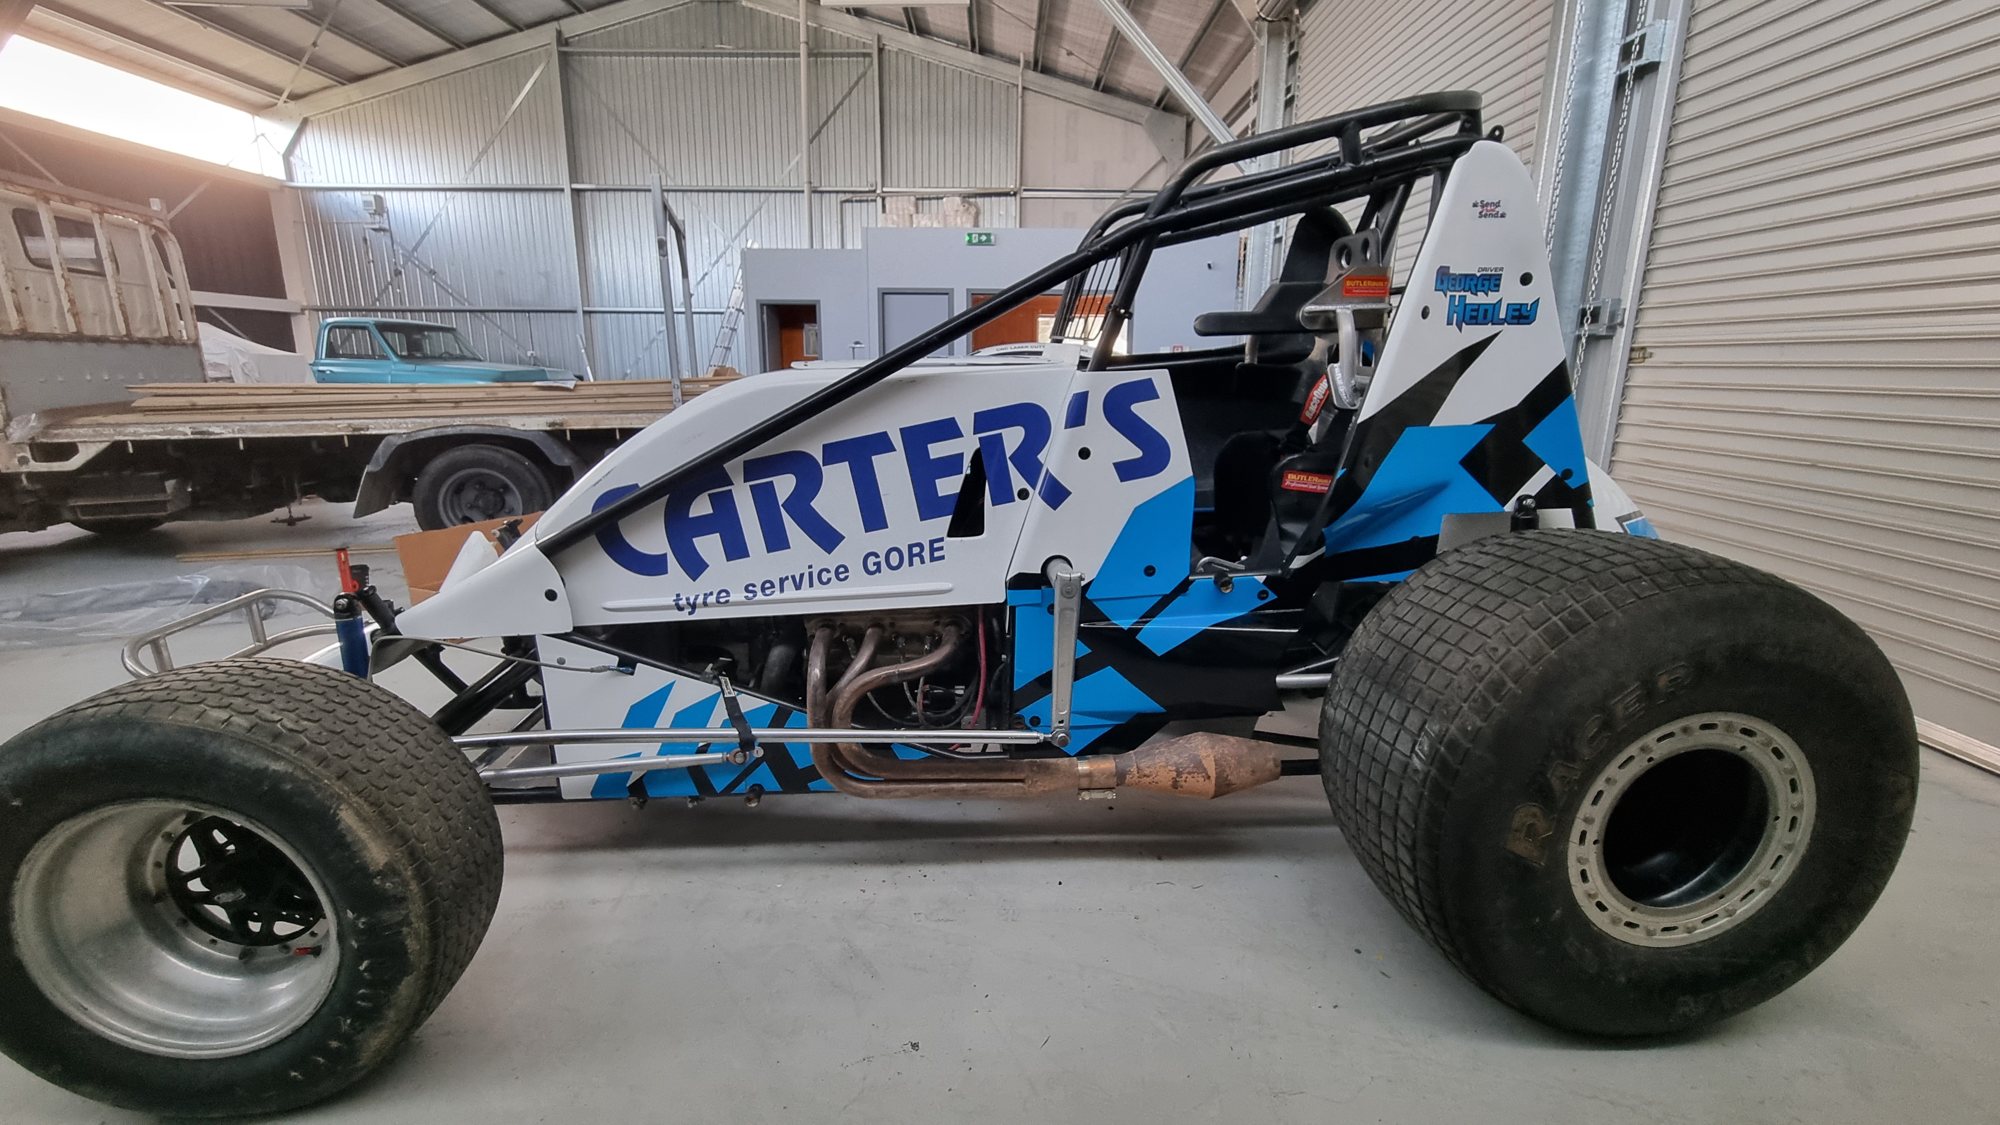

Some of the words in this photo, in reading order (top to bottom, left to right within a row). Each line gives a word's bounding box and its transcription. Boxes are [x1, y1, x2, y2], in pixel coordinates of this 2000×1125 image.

[1478, 210, 1500, 219] Send
[1446, 294, 1541, 334] HEDLEY
[591, 377, 1172, 583] CARTER'S
[673, 588, 731, 616] tyre
[743, 564, 850, 602] service
[862, 536, 946, 577] GORE
